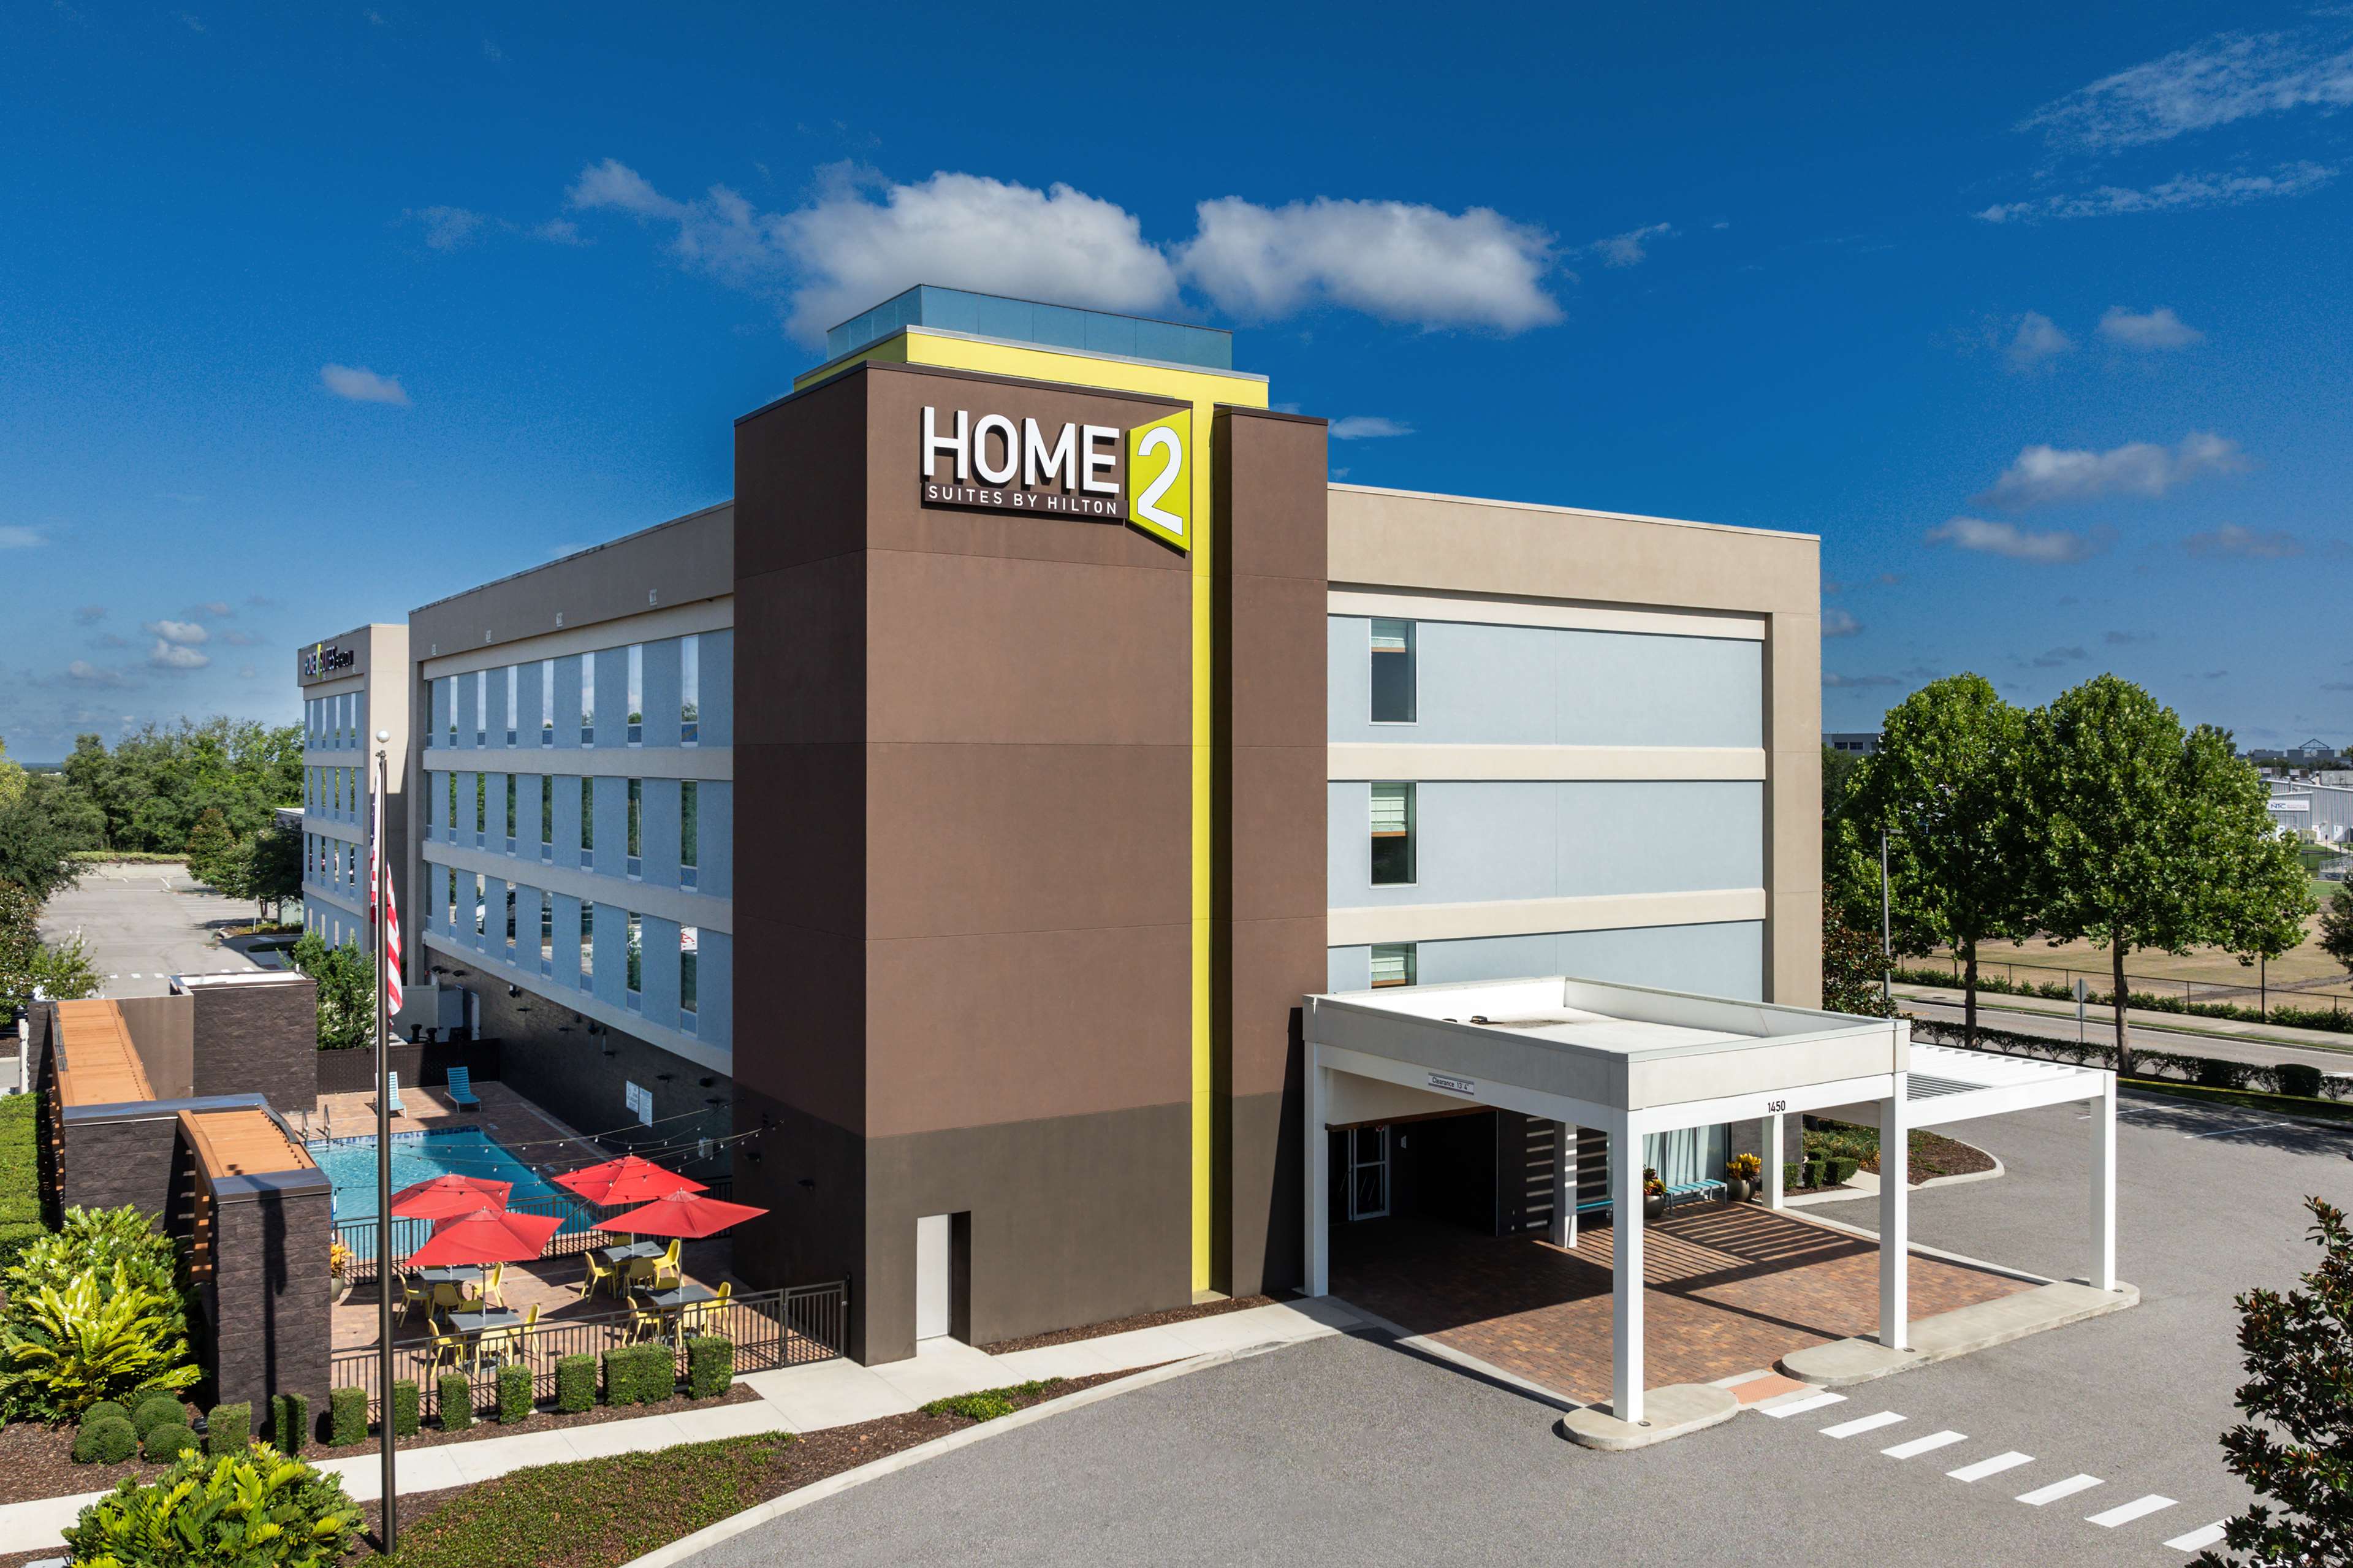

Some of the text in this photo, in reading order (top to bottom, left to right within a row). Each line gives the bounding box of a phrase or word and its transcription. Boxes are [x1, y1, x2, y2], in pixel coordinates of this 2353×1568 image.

[924, 406, 1183, 536] HOME 2
[929, 485, 1116, 515] SUITES BY HILTON
[1432, 1076, 1454, 1087] Clearance
[1768, 1100, 1785, 1113] 1450
